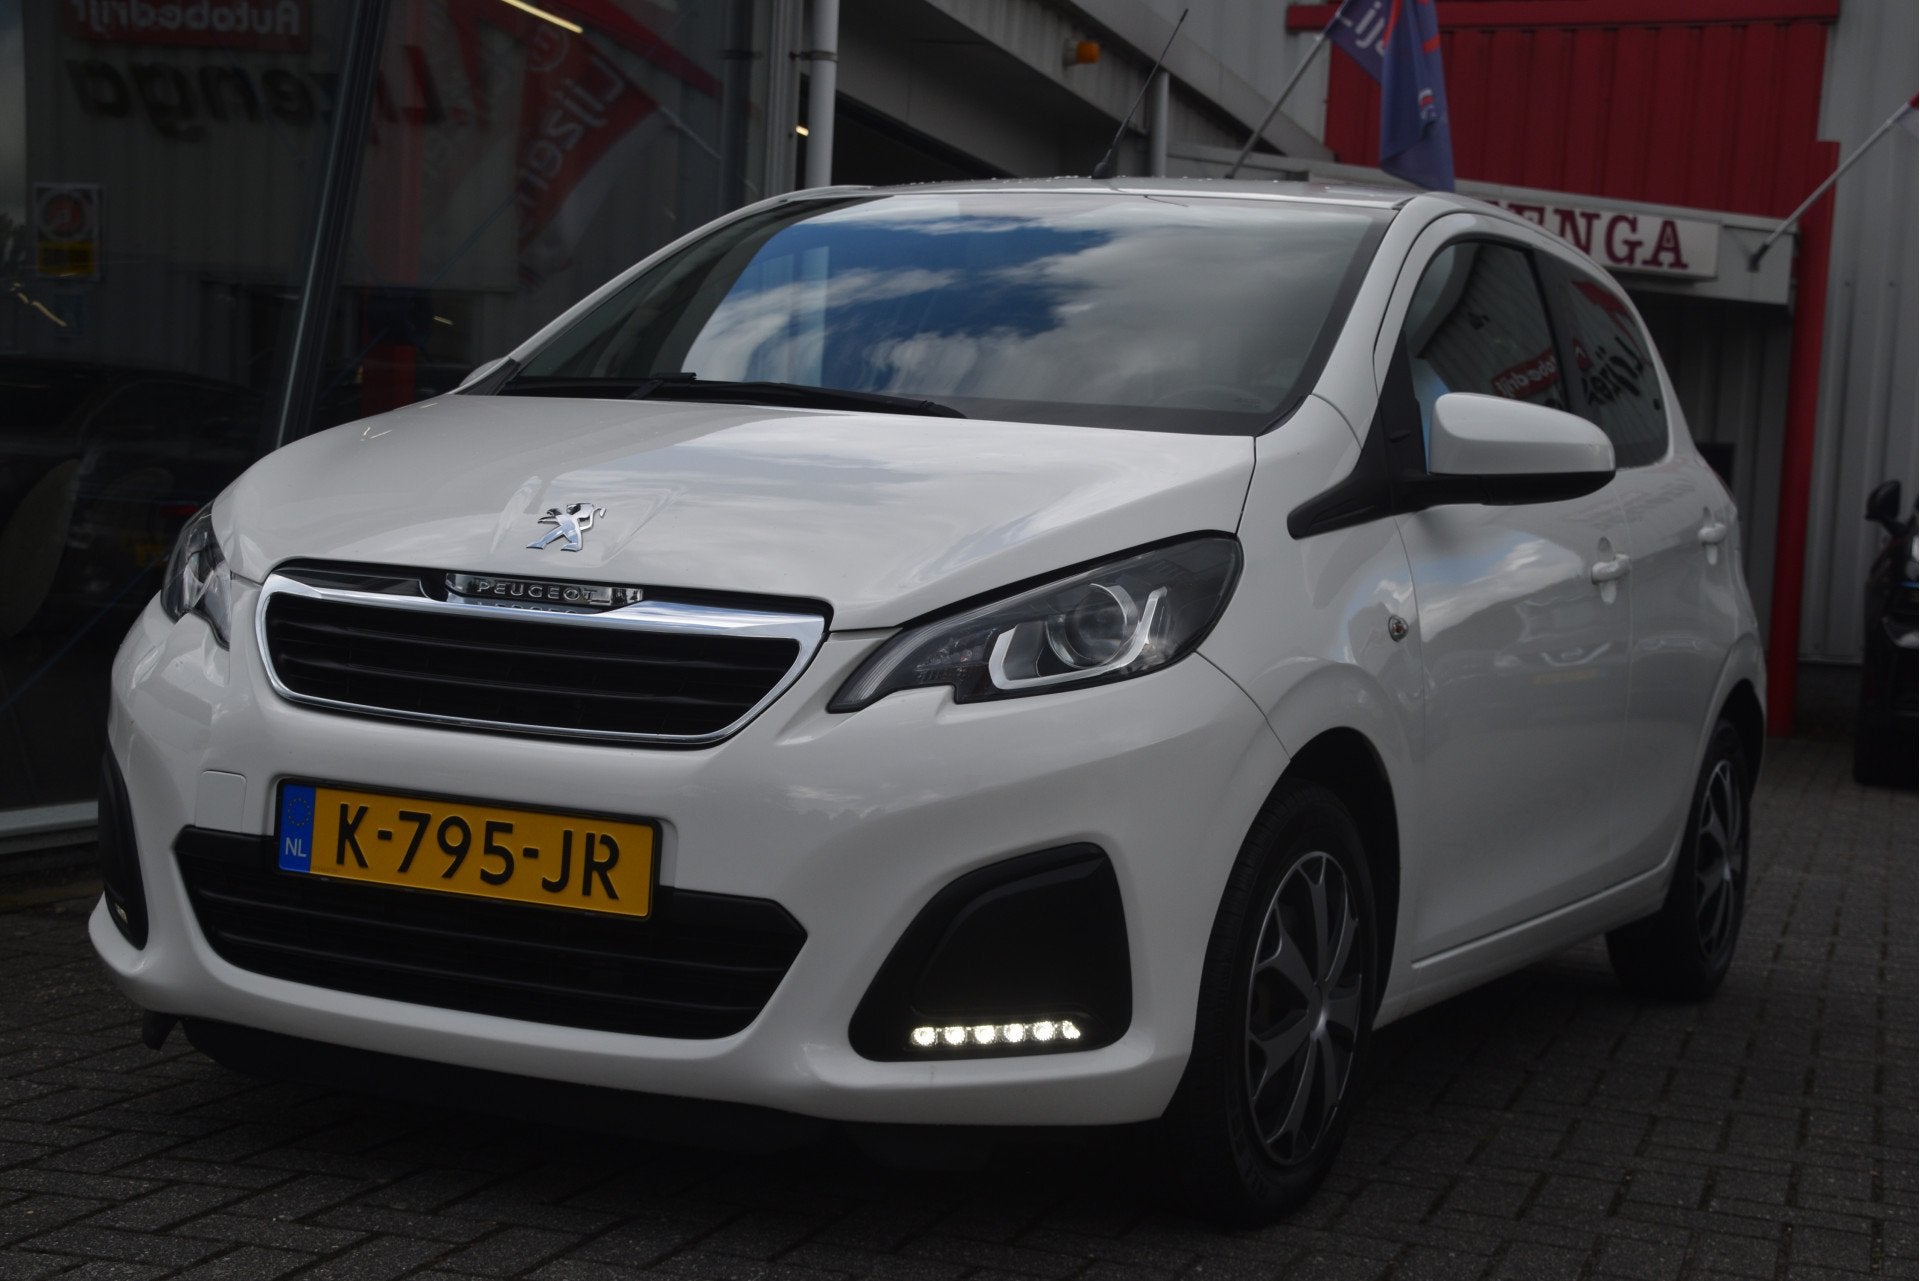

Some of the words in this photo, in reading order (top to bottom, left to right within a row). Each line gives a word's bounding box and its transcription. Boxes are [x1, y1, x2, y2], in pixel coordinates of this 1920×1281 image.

[476, 581, 598, 601] PEUGEOT
[284, 837, 308, 858] NL
[335, 802, 620, 901] K-795-JR
